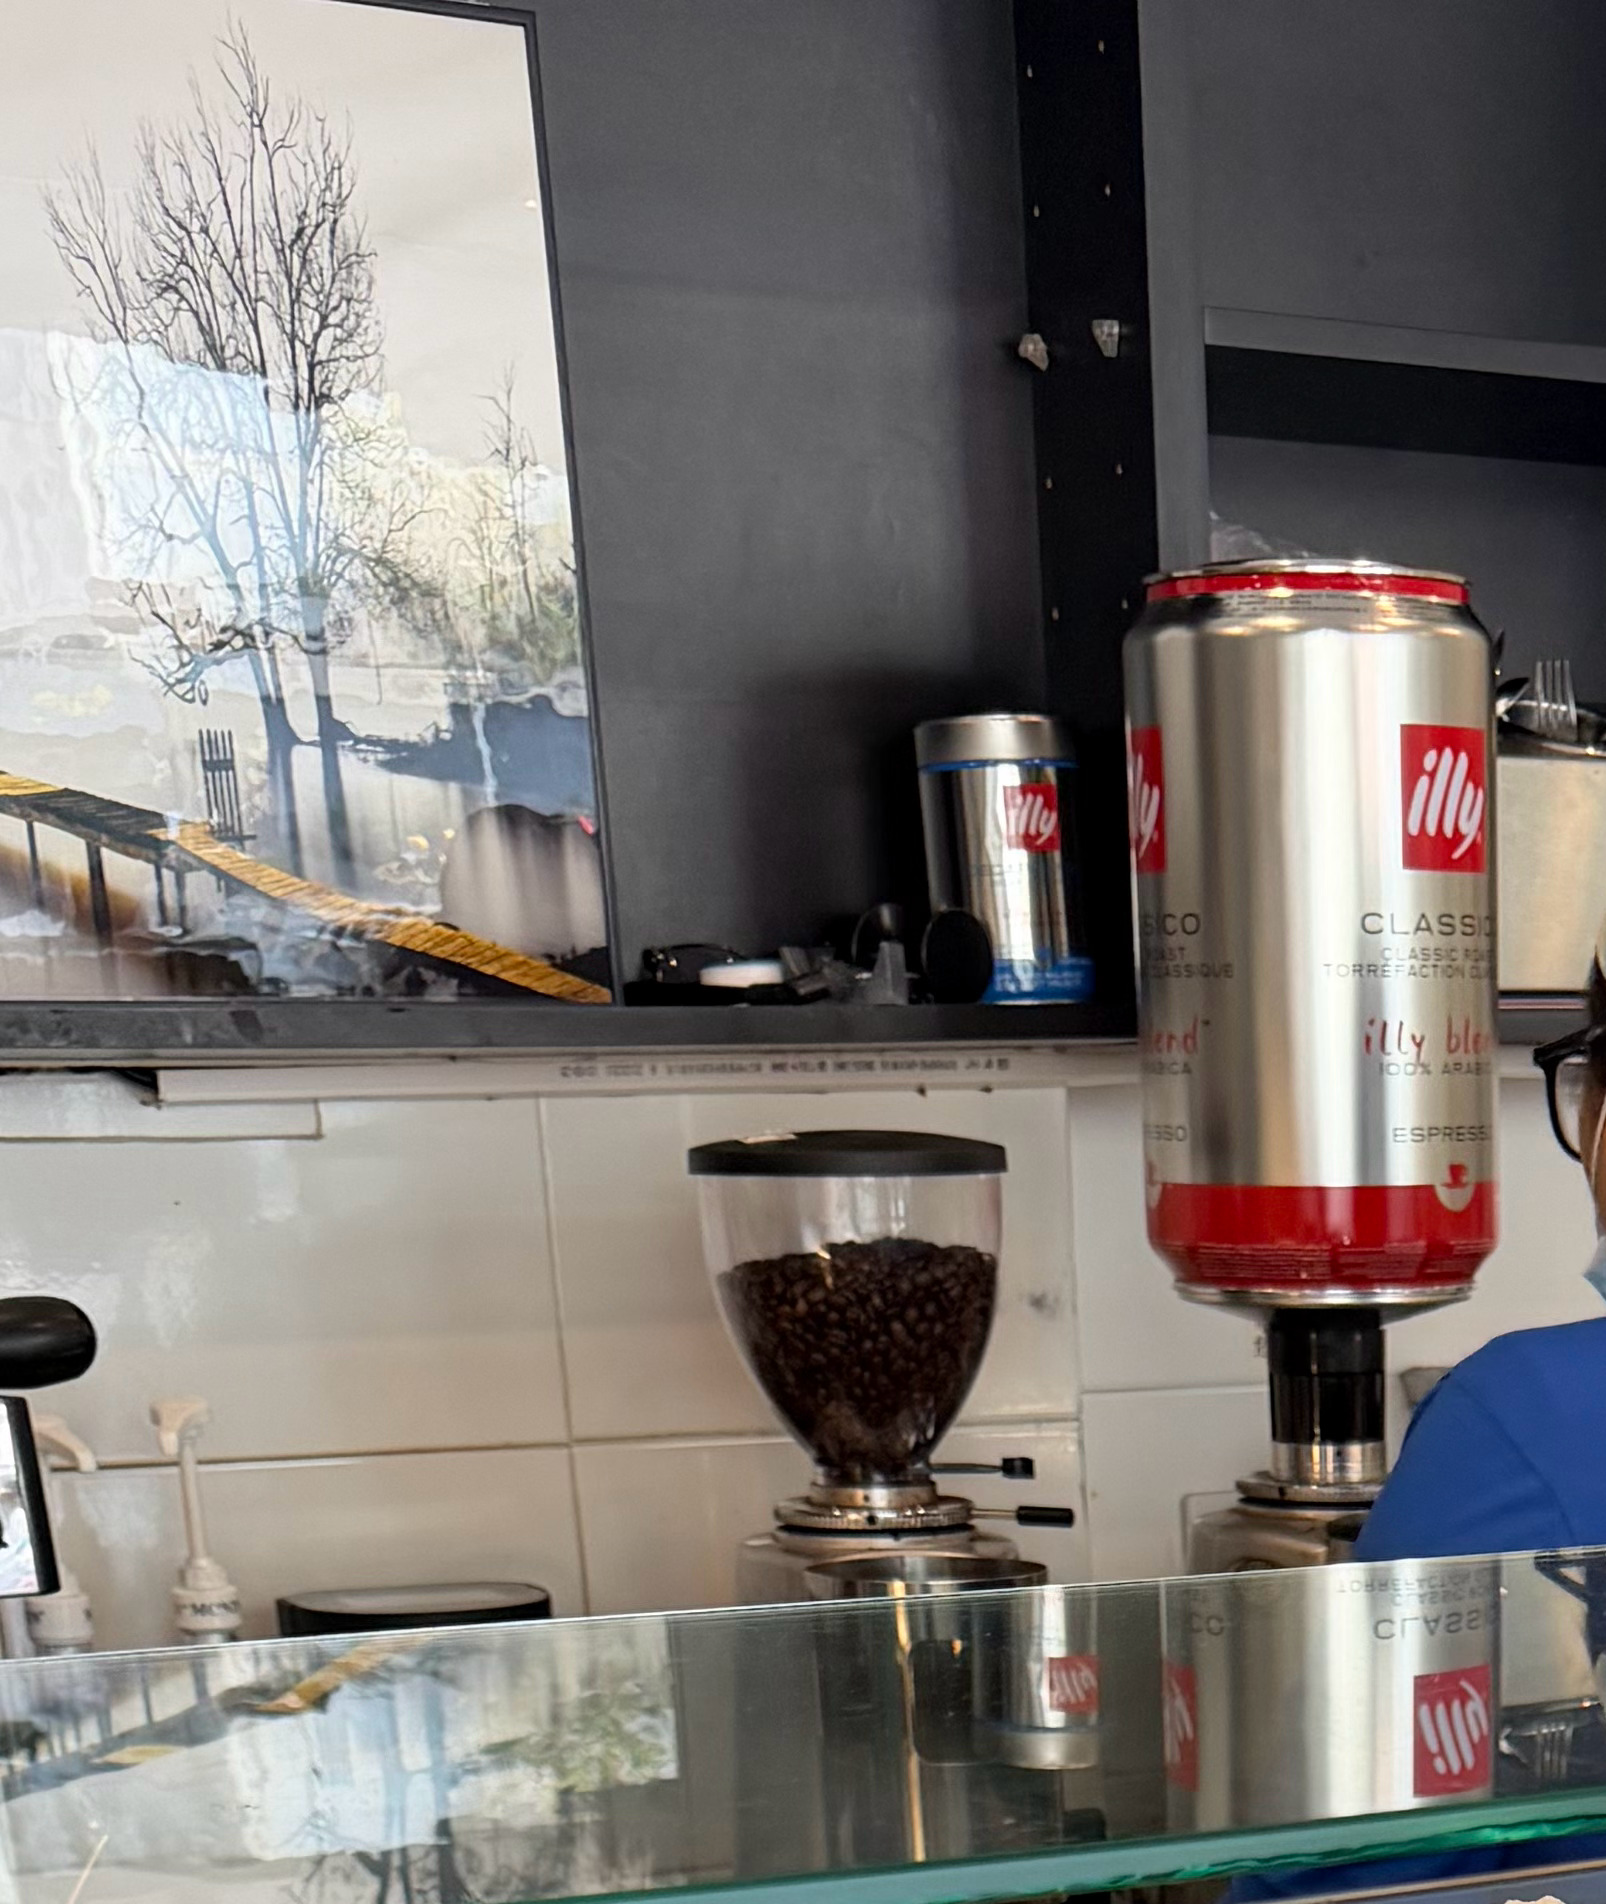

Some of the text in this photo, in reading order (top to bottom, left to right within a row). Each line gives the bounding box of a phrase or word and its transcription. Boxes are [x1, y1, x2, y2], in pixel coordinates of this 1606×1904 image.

[1009, 793, 1057, 845] illy
[1408, 746, 1483, 860] illy
[1363, 1016, 1426, 1066] illy
